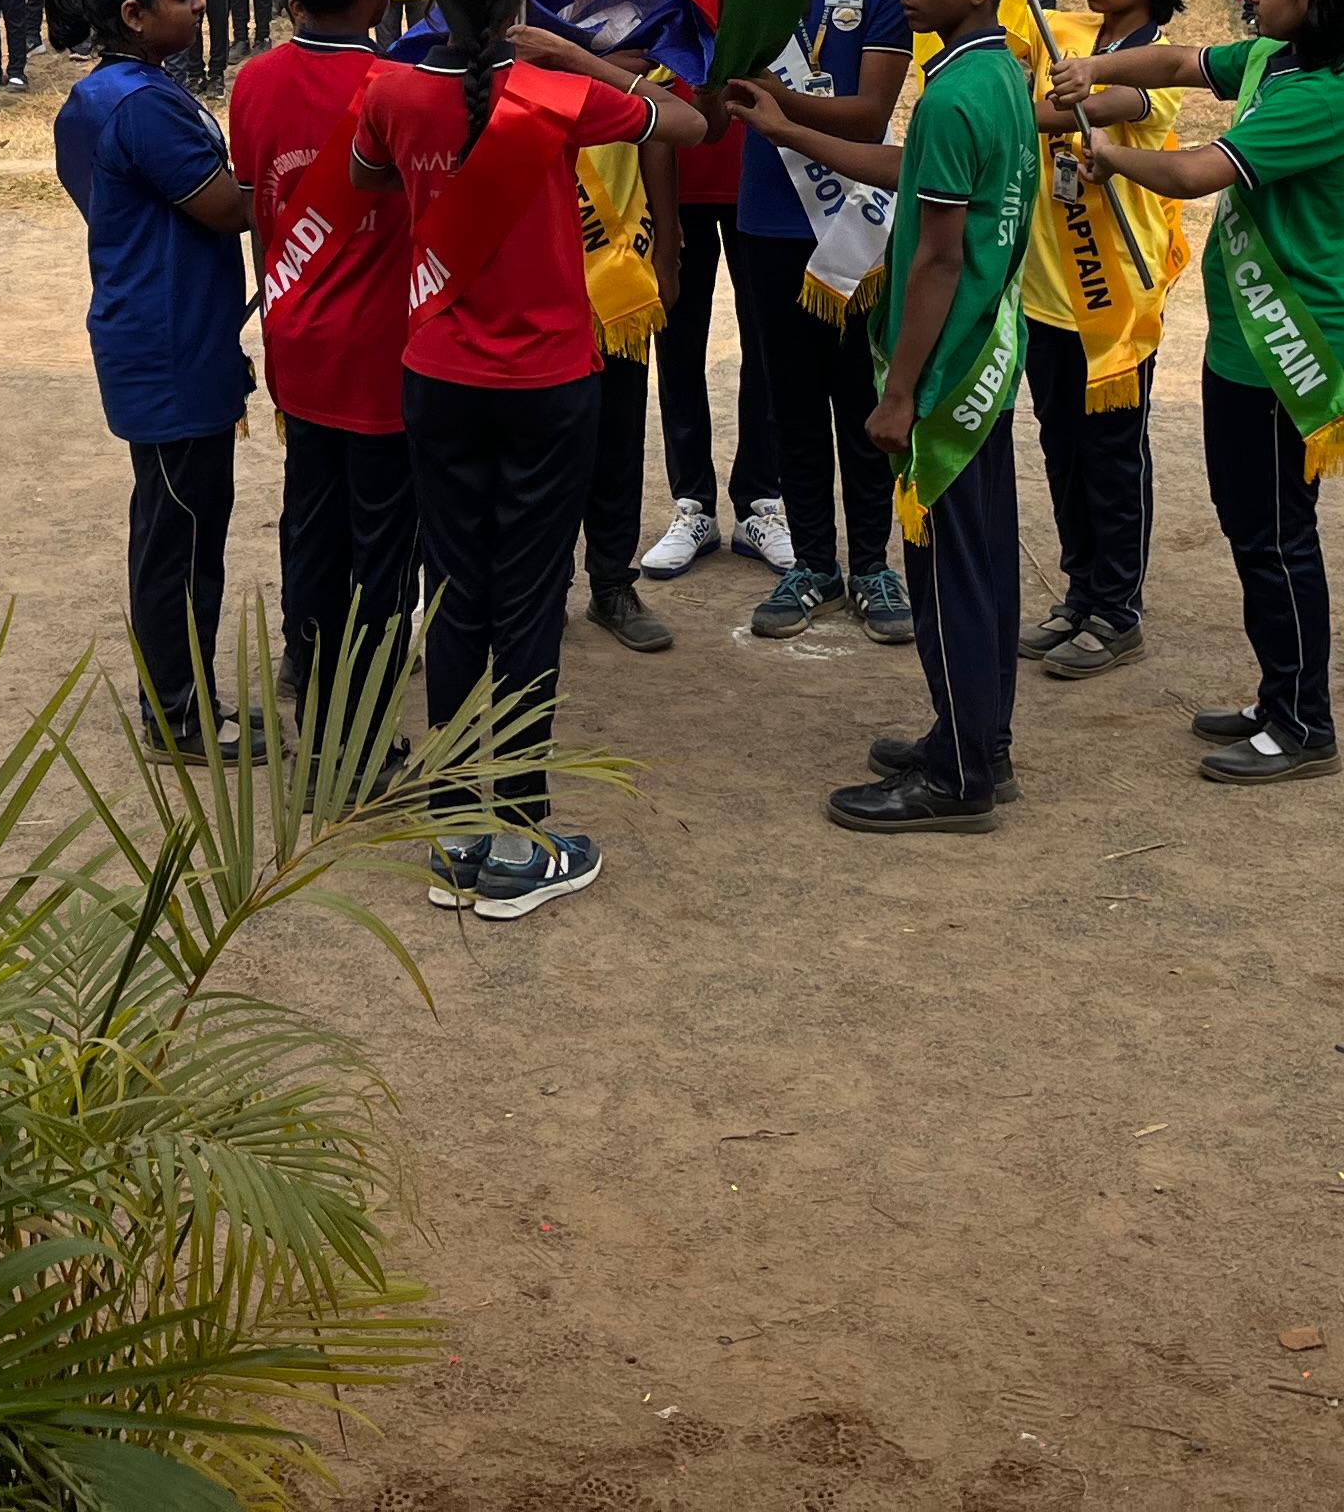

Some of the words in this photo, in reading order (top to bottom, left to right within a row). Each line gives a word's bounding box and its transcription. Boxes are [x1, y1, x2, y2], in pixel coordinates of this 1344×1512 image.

[262, 206, 334, 319] ANADI
[576, 175, 611, 254] TAIN
[1218, 189, 1249, 256] RLS
[1234, 260, 1328, 397] CAPTAIN
[952, 283, 1022, 431] SUBAR
[690, 518, 710, 546] NSC
[745, 522, 766, 548] NSC
